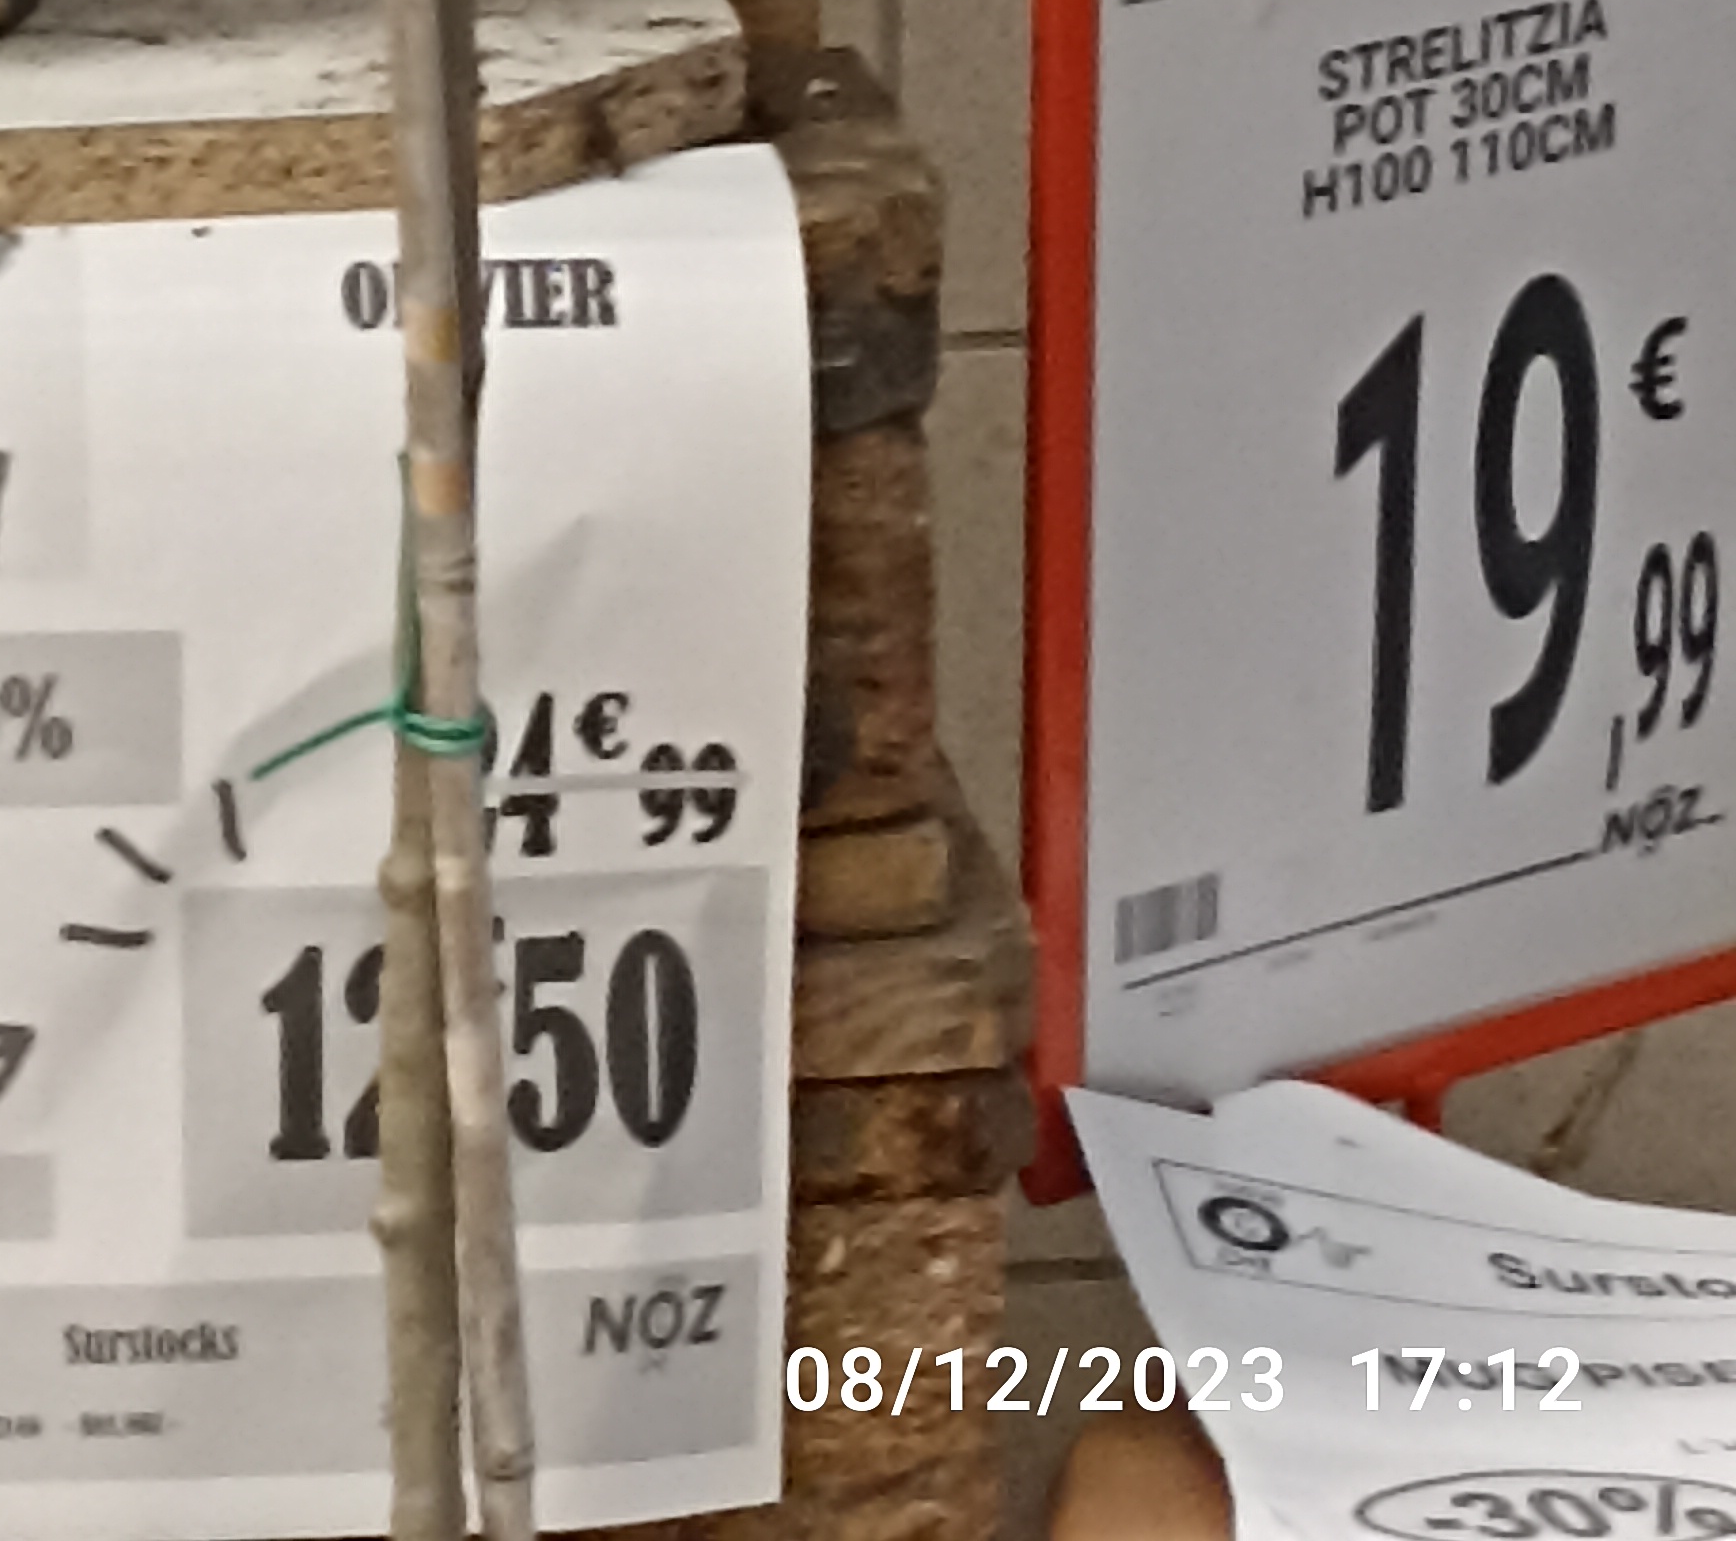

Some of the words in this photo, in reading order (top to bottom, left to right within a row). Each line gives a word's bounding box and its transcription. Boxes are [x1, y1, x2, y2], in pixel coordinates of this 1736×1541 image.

[1332, 87, 1437, 156] POT
[1450, 51, 1591, 129] 30CM
[1301, 143, 1433, 219] H100
[1450, 101, 1616, 184] 110CM
[64, 1323, 241, 1364] Surstocks
[581, 1275, 725, 1356] NOZ
